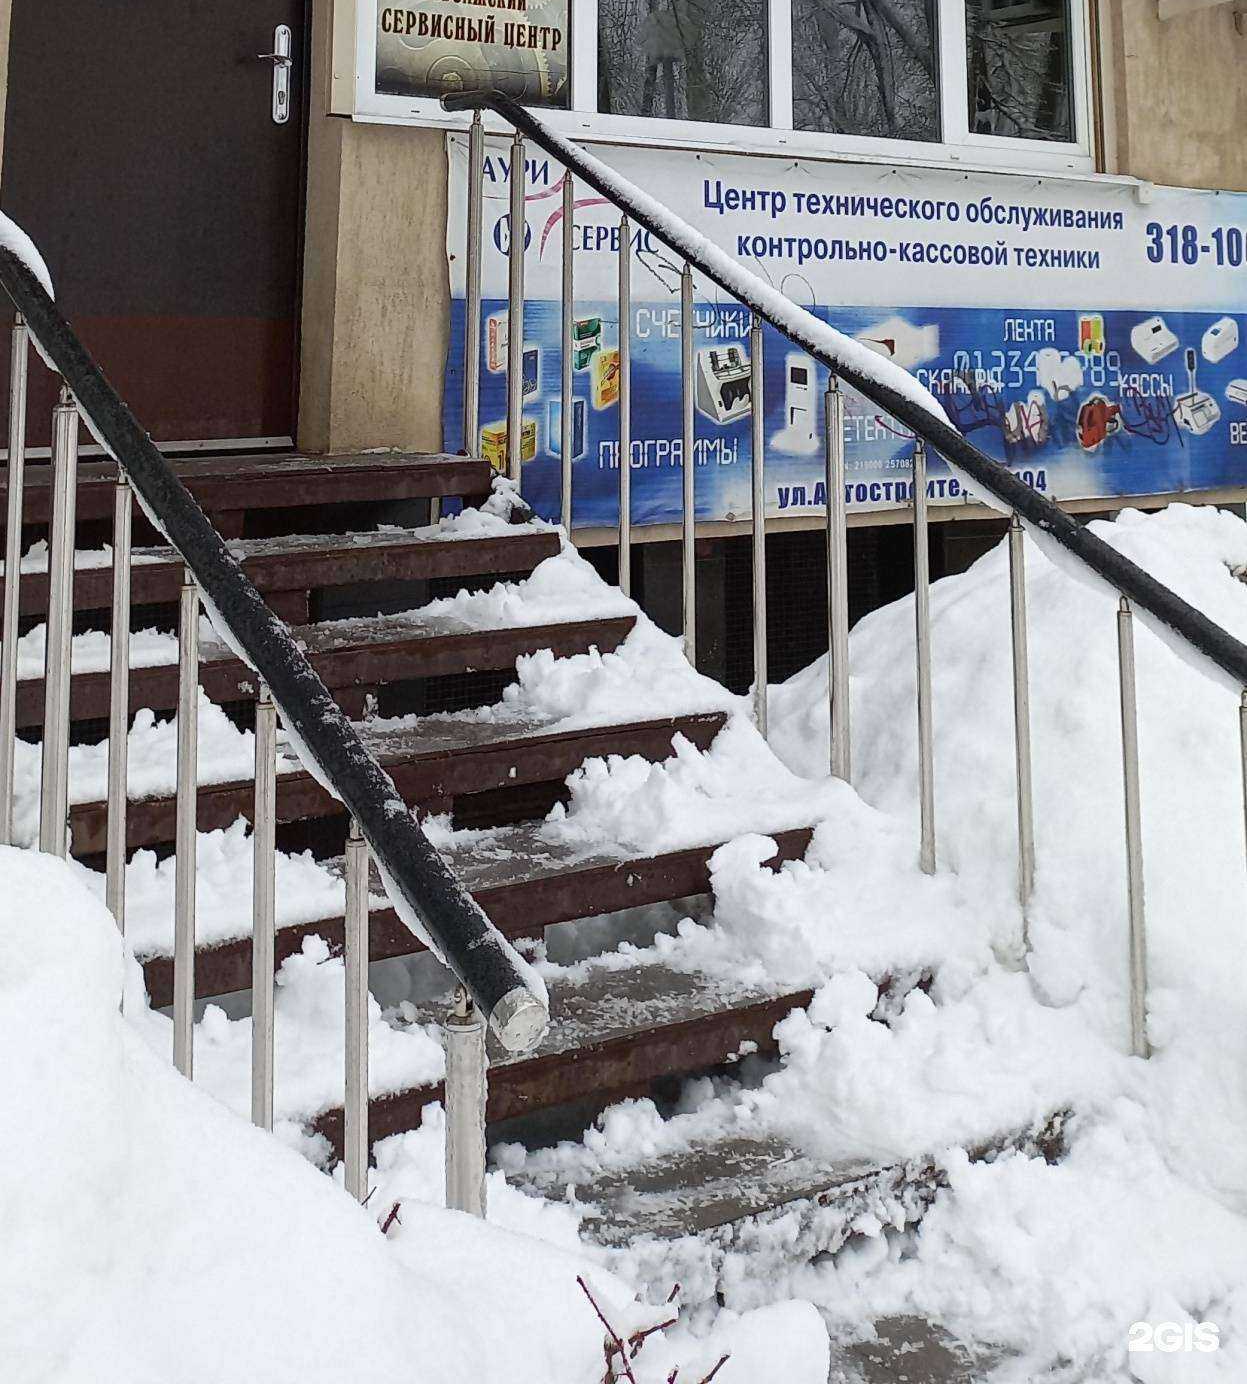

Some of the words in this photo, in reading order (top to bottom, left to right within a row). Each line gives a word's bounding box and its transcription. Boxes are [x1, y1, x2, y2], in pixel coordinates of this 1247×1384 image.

[381, 7, 495, 44] СЕРВИСНЫЙ
[503, 22, 562, 51] ЦЕНТР
[703, 179, 787, 219] Центр
[793, 191, 960, 222] технического
[966, 196, 1124, 231] обслуживания
[737, 235, 1008, 266] контрольно-кассовой
[1014, 247, 1101, 269] техники
[1146, 222, 1247, 267] 318-10
[636, 308, 754, 339] СЧЕЧИКИ
[1003, 319, 1055, 342] ЛЕНТА
[916, 368, 1002, 394] СКАНРЫ
[1119, 373, 1174, 398] КАССЫ
